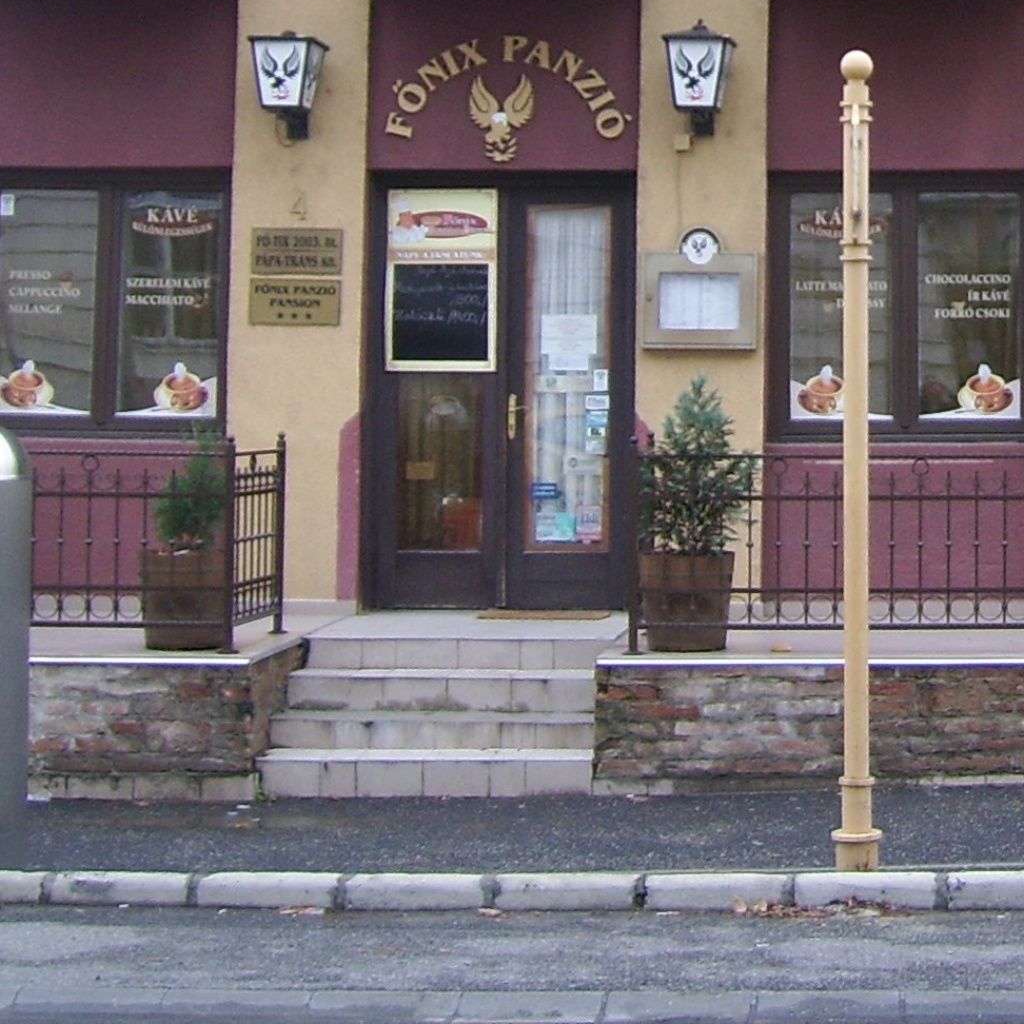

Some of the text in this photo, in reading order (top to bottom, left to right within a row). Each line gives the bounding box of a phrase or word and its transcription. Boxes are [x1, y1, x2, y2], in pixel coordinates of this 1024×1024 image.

[385, 35, 632, 139] FŐNIX PANZIÓ
[147, 205, 199, 223] KÁVÉ
[815, 207, 844, 225] KÁ
[924, 274, 1012, 285] CHOCOLACCINO
[795, 281, 826, 292] LATTE
[8, 287, 81, 298] CAPPUCCINO
[982, 288, 1011, 302] KÁVÉ
[125, 295, 194, 306] MACCHIATO
[8, 304, 63, 314] MELANGE
[975, 307, 1011, 319] CSOKI
